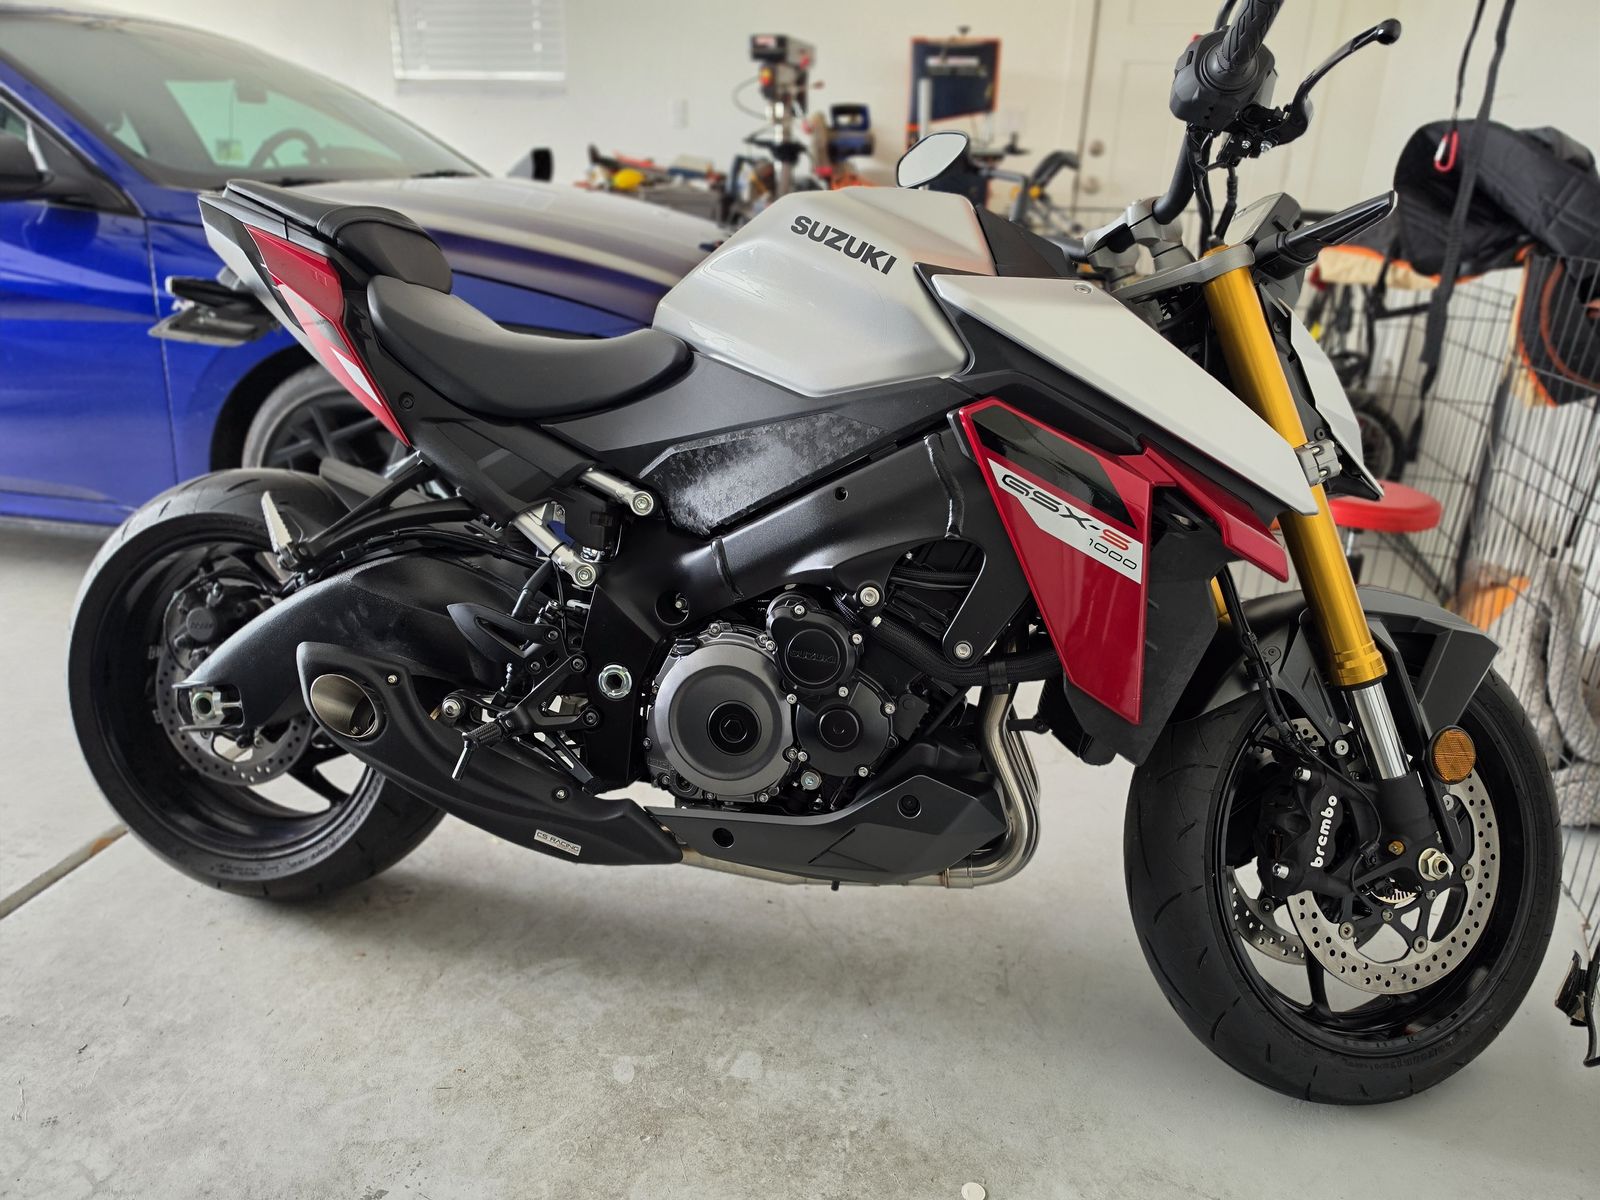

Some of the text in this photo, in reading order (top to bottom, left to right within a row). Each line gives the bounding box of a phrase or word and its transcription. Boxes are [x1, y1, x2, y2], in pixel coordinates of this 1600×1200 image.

[790, 215, 898, 275] SUZUKI
[1001, 474, 1133, 551] GSX-S
[1088, 537, 1138, 570] 1000
[550, 836, 579, 852] RACING
[1310, 795, 1338, 868] brembo
